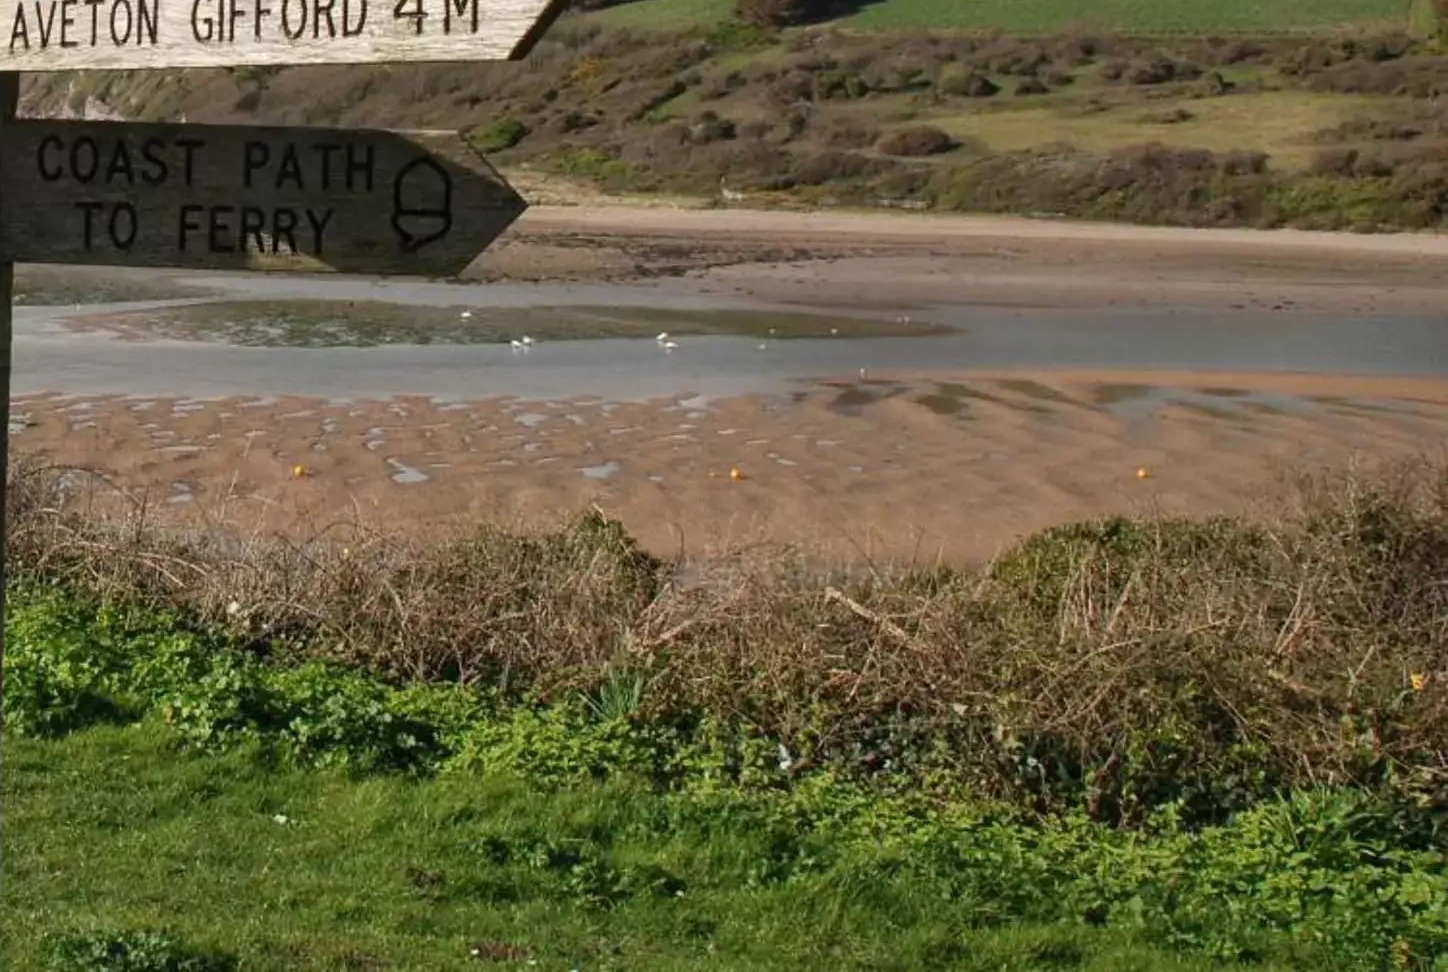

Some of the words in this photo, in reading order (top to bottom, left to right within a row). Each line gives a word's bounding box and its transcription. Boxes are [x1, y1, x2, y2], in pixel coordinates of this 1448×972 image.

[37, 133, 205, 188] COAST
[242, 139, 375, 192] PATH
[74, 201, 138, 250] TO
[178, 205, 334, 256] FERRY
